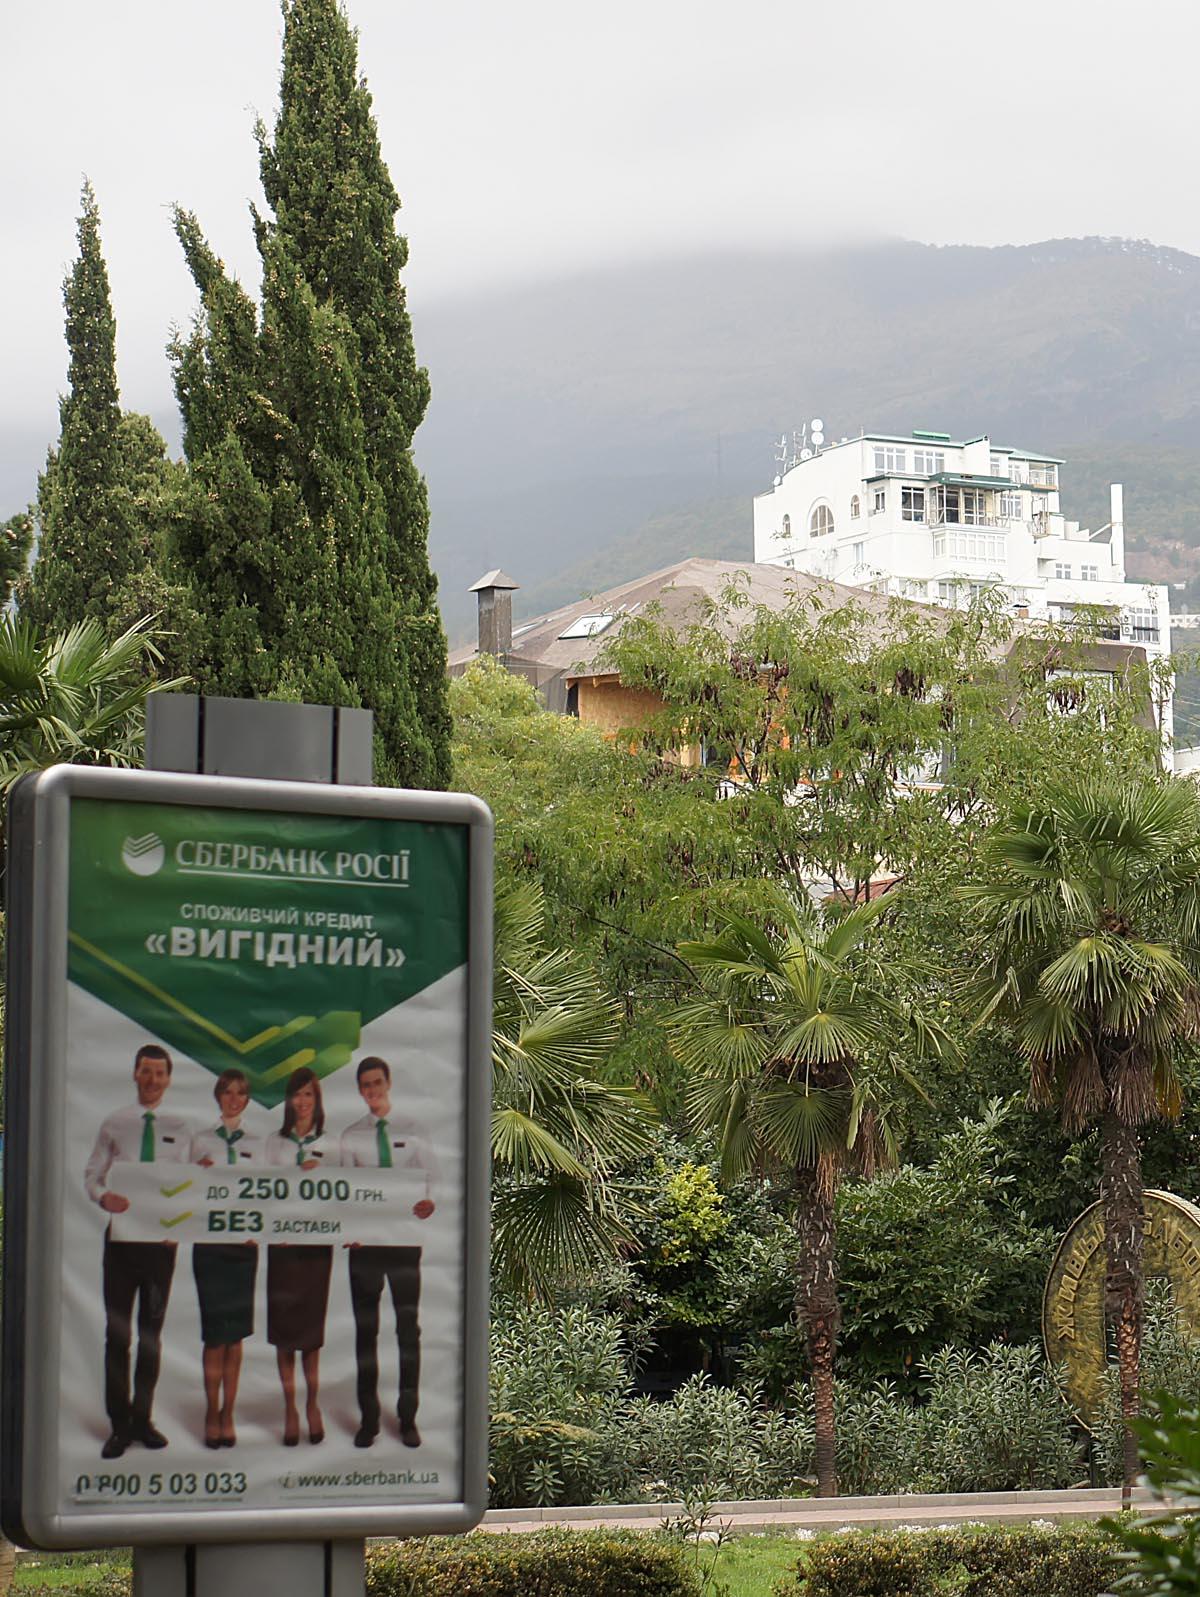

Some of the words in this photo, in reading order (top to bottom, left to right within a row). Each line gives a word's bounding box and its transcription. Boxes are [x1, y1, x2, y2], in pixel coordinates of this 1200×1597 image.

[175, 839, 329, 876] СБЕРБАНК
[335, 849, 410, 881] РОСІЇ
[180, 903, 300, 926] СПОЖИВЧИЙ
[304, 911, 375, 931] КРЕДИТ
[144, 926, 407, 969] «ВИГІДНИЙ»
[207, 1186, 230, 1201] ДО
[238, 1178, 290, 1201] 250
[299, 1179, 350, 1202] 000
[355, 1189, 388, 1202] ГРН.
[208, 1211, 264, 1233] БЕЗ
[272, 1220, 342, 1234] ЗАСТАВИ
[1057, 1221, 1107, 1341] ЖИВЫ
[147, 1473, 163, 1496] 5
[169, 1472, 198, 1495] 03
[204, 1472, 248, 1494] 033
[297, 1468, 440, 1487] www.sberbank.ua
